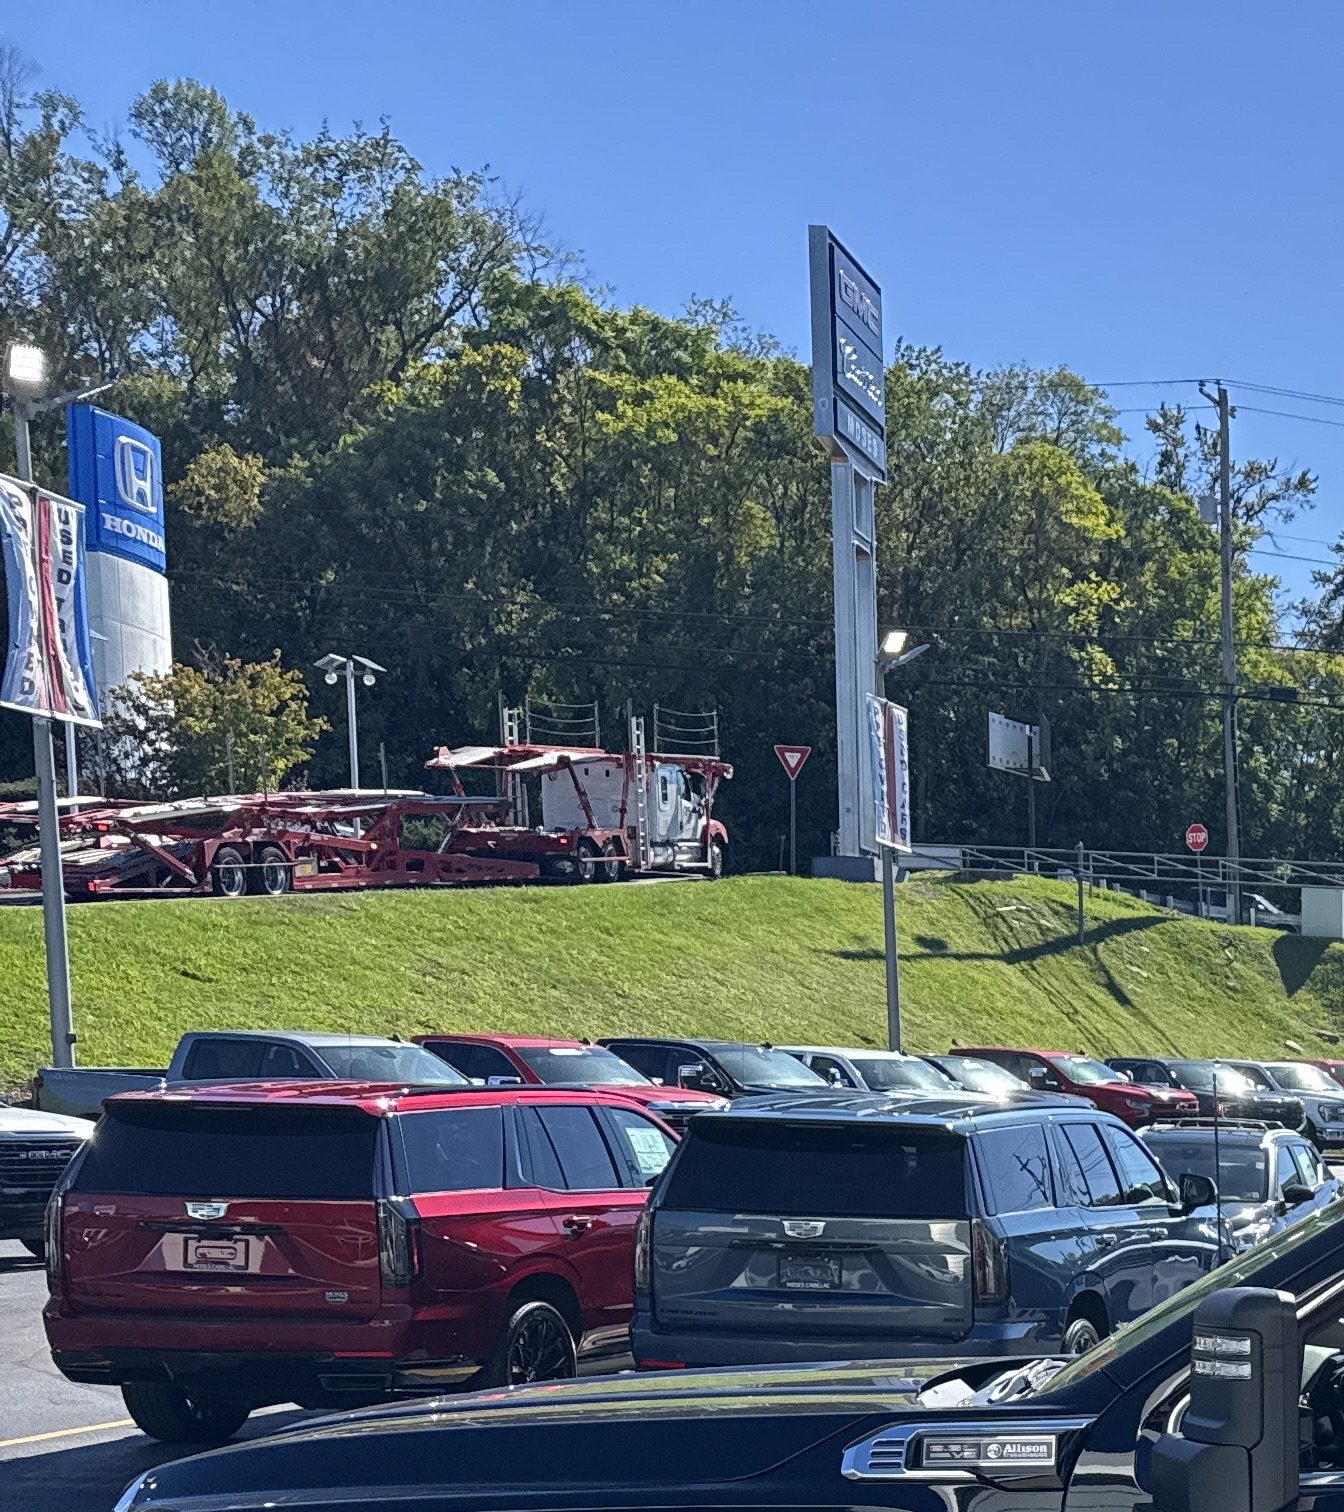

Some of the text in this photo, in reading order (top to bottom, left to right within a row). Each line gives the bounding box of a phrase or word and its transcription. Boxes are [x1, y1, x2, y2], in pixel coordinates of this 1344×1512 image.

[839, 269, 880, 337] GMC
[846, 414, 879, 459] MOSES
[57, 507, 74, 586] USED
[1187, 831, 1207, 844] STOP
[1004, 1443, 1048, 1453] Allison
